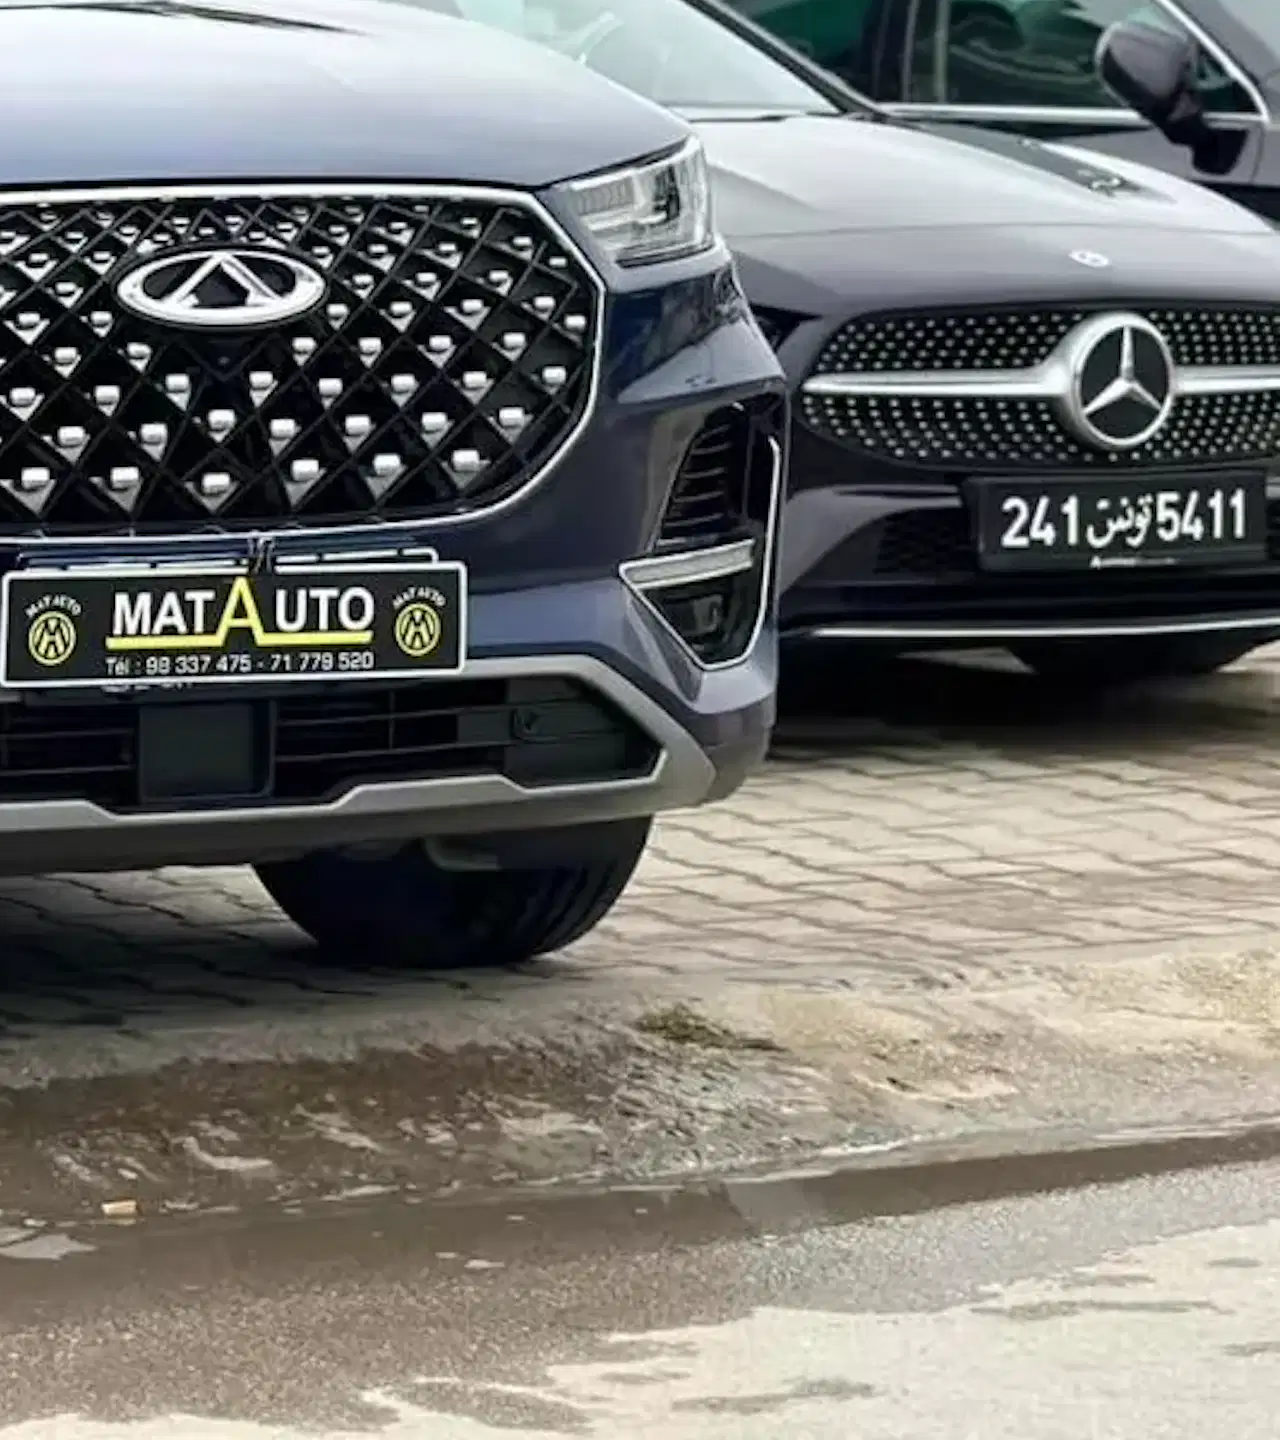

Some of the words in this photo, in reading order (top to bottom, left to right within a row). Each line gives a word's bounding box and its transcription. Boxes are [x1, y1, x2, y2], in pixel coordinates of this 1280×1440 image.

[1001, 493, 1080, 548] 241
[1087, 493, 1154, 548] تونس
[1155, 487, 1247, 542] 5411
[174, 655, 211, 674] 337
[215, 653, 252, 673] 475
[270, 653, 292, 672] 71
[298, 651, 334, 672] 779
[337, 650, 376, 670] 520
